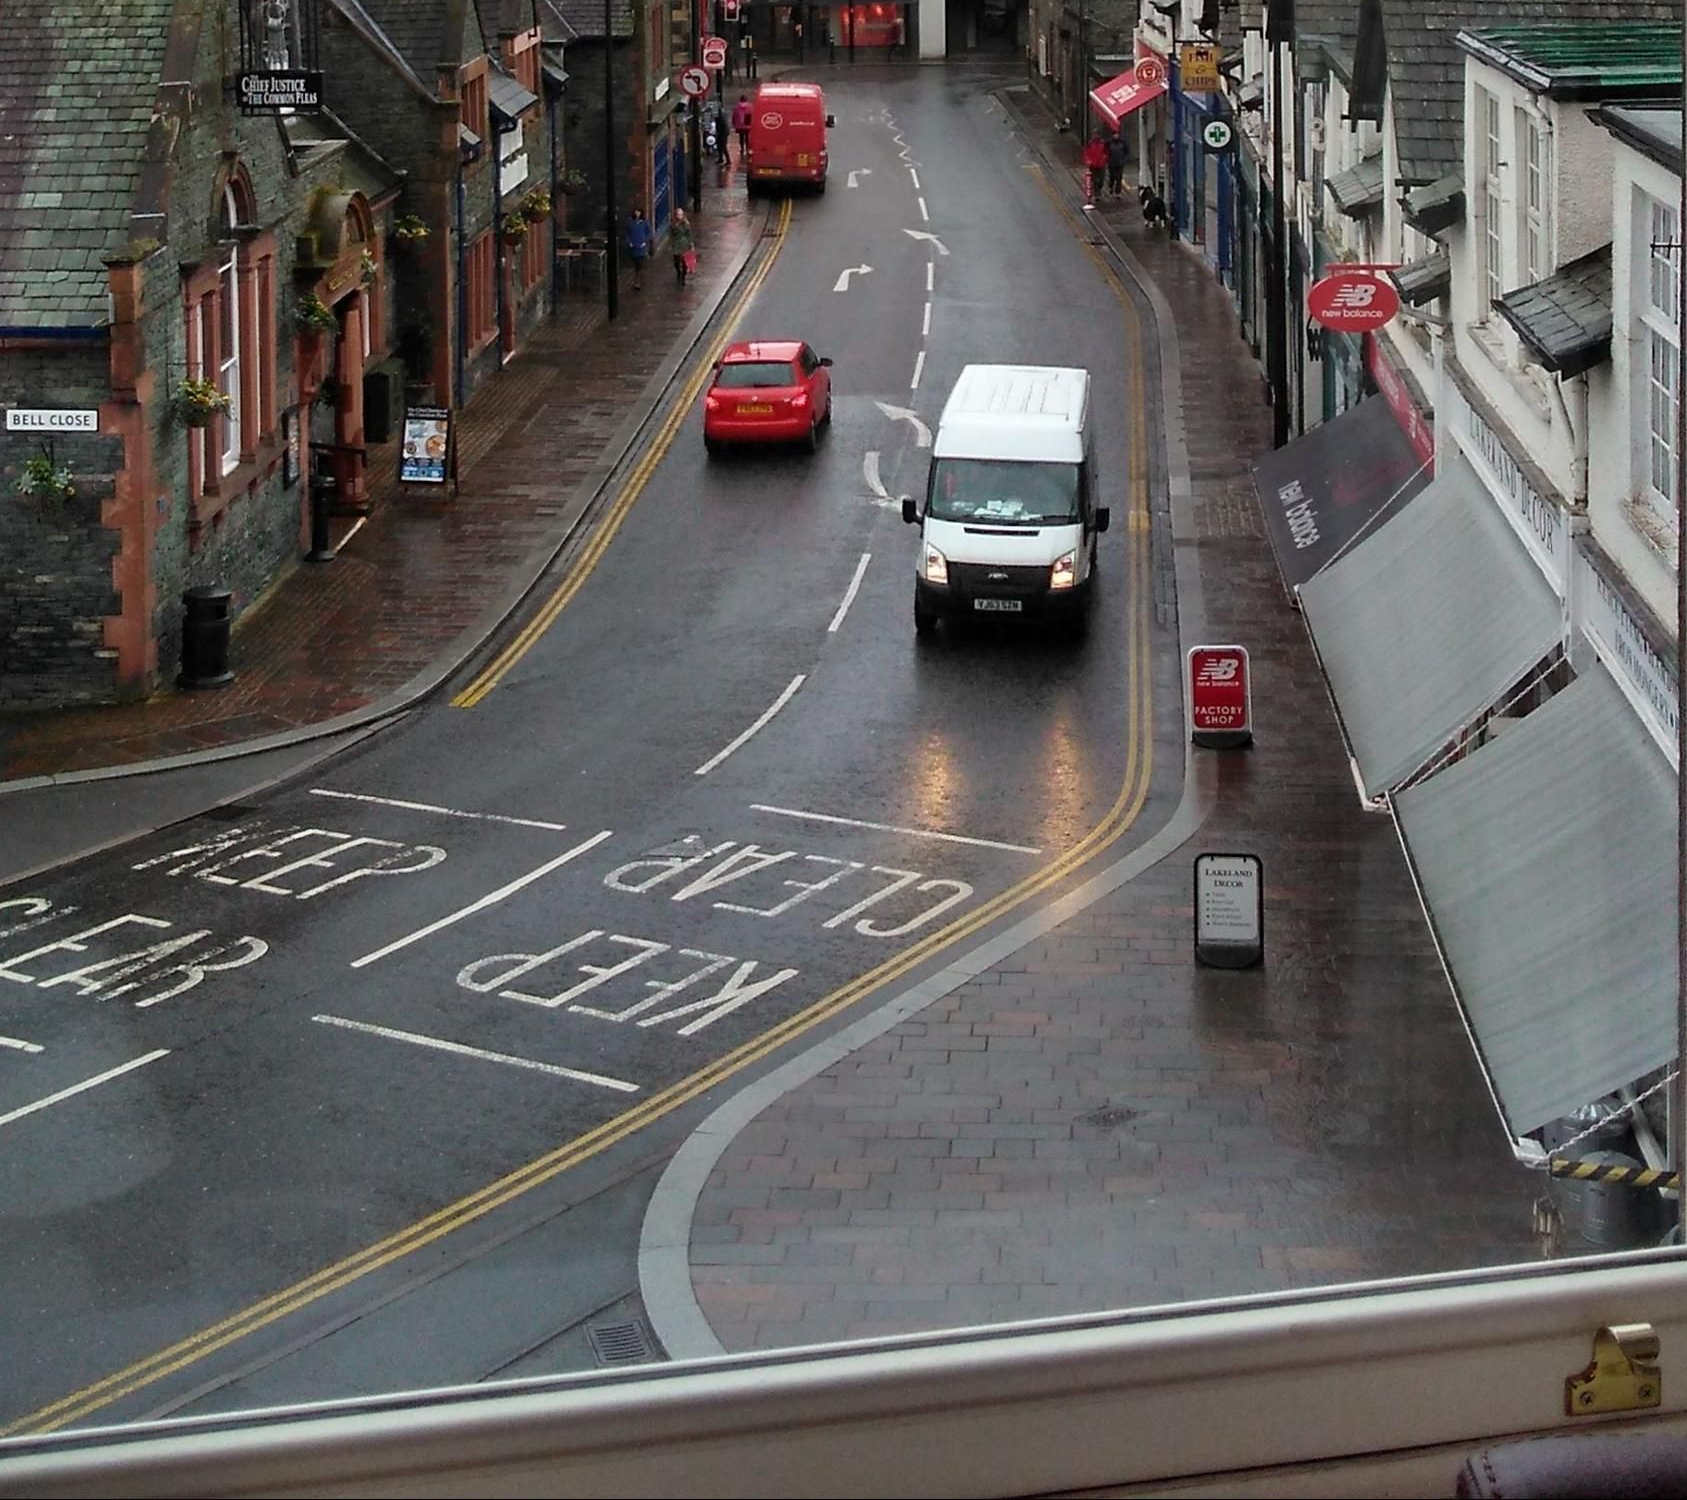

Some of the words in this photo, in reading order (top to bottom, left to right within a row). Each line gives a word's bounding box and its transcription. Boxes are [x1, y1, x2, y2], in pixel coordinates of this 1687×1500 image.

[1195, 64, 1207, 75] &
[241, 76, 269, 93] CHIEF
[270, 76, 306, 92] JUSTICE
[1185, 76, 1217, 86] CHIPS
[263, 92, 295, 105] COMMON
[296, 92, 318, 104] PLEAS
[1321, 310, 1341, 318] new
[1343, 309, 1383, 318] balance
[12, 414, 45, 426] BELL
[49, 414, 91, 426] CLOSE
[1278, 479, 1305, 507] new
[1520, 474, 1554, 555] DECOR
[1285, 498, 1321, 549] balance
[1195, 706, 1243, 715] FACTORY
[1205, 715, 1234, 724] SHOP
[131, 819, 447, 899] KEEP
[1205, 868, 1253, 877] LAKELAND
[603, 834, 974, 938] CLEAR
[455, 929, 799, 1037] KEEP
